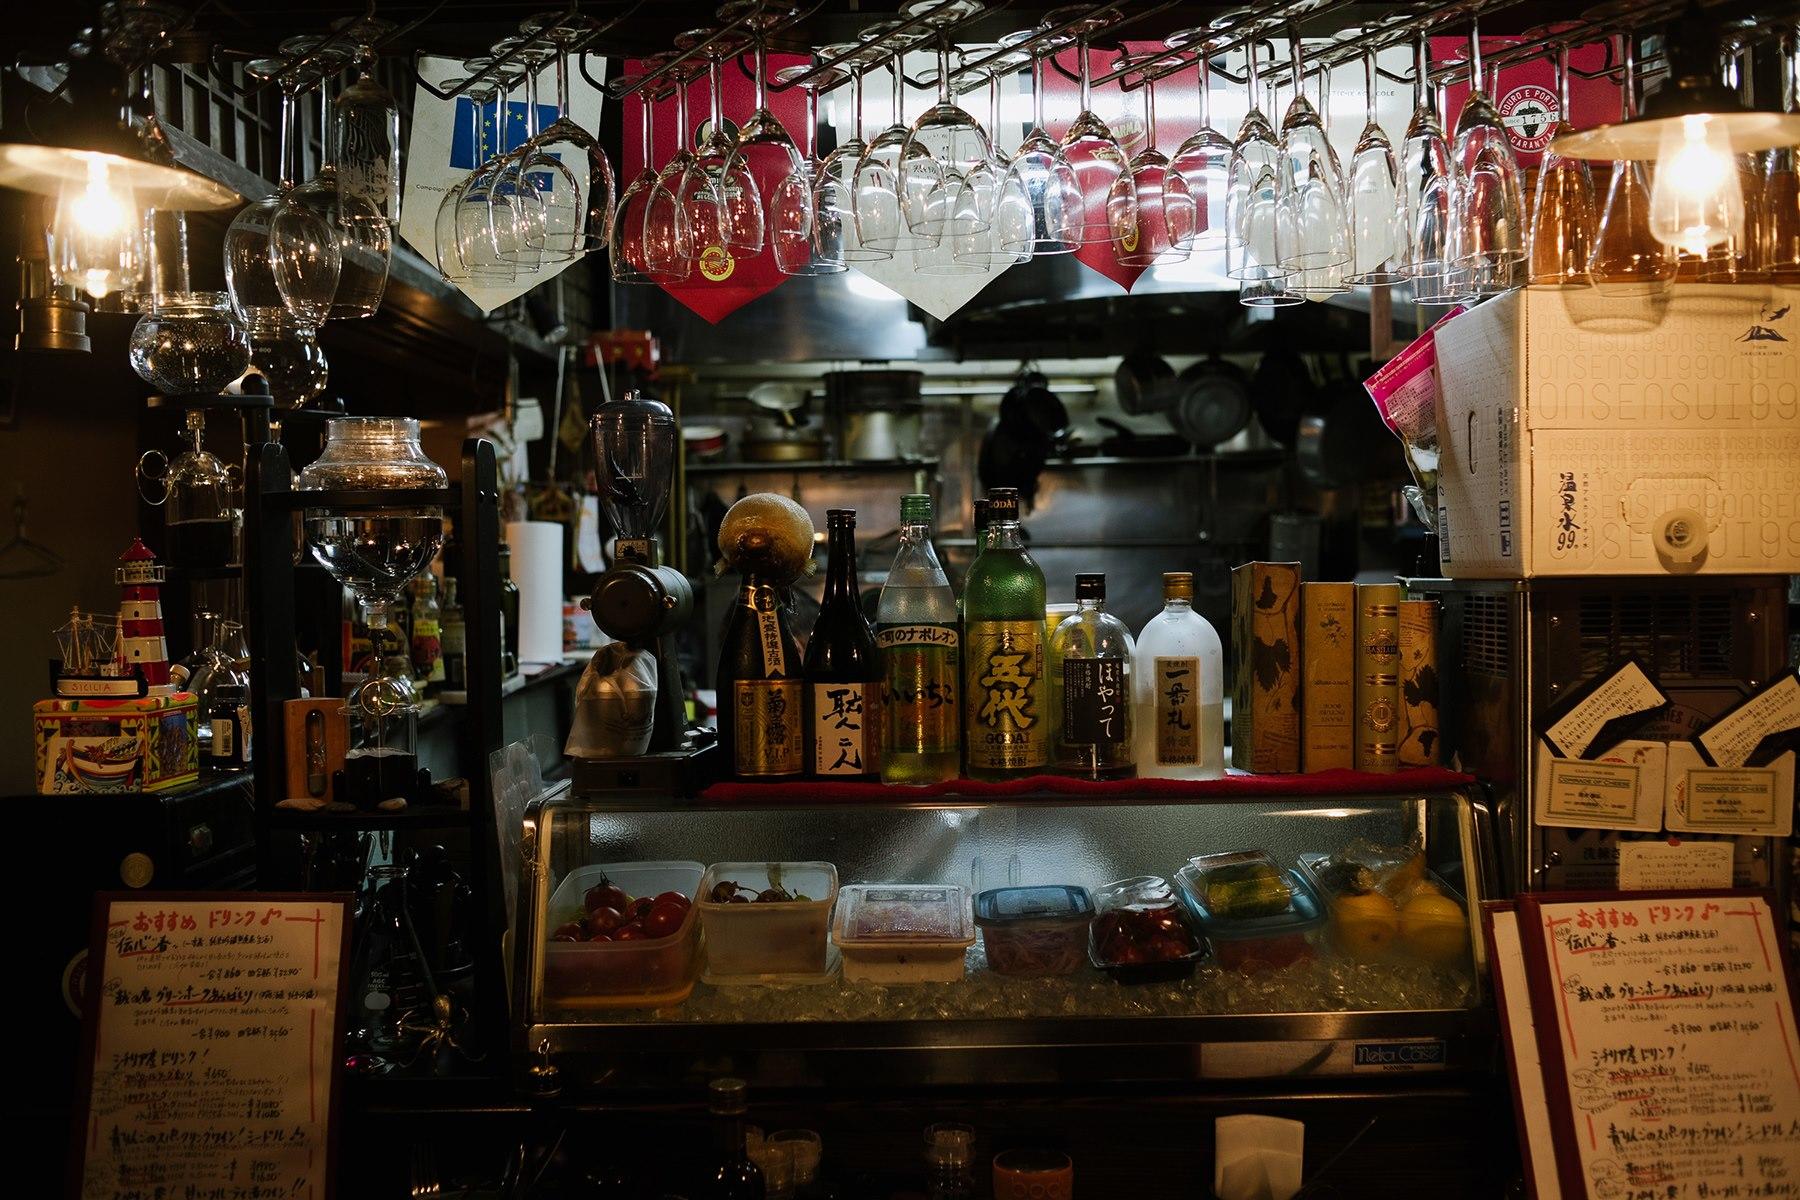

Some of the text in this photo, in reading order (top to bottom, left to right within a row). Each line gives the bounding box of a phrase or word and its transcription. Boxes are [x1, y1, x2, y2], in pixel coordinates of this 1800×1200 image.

[1501, 89, 1558, 116] DOURO E PORTO
[1522, 113, 1556, 125] 1756
[988, 499, 1017, 510] GODAI
[72, 683, 111, 692] SICILIA
[980, 654, 1035, 729] 五代
[1096, 662, 1115, 738] ほやって
[133, 909, 256, 932] おすすめ ドリンク
[1577, 906, 1695, 929] おすすめ ドリンク
